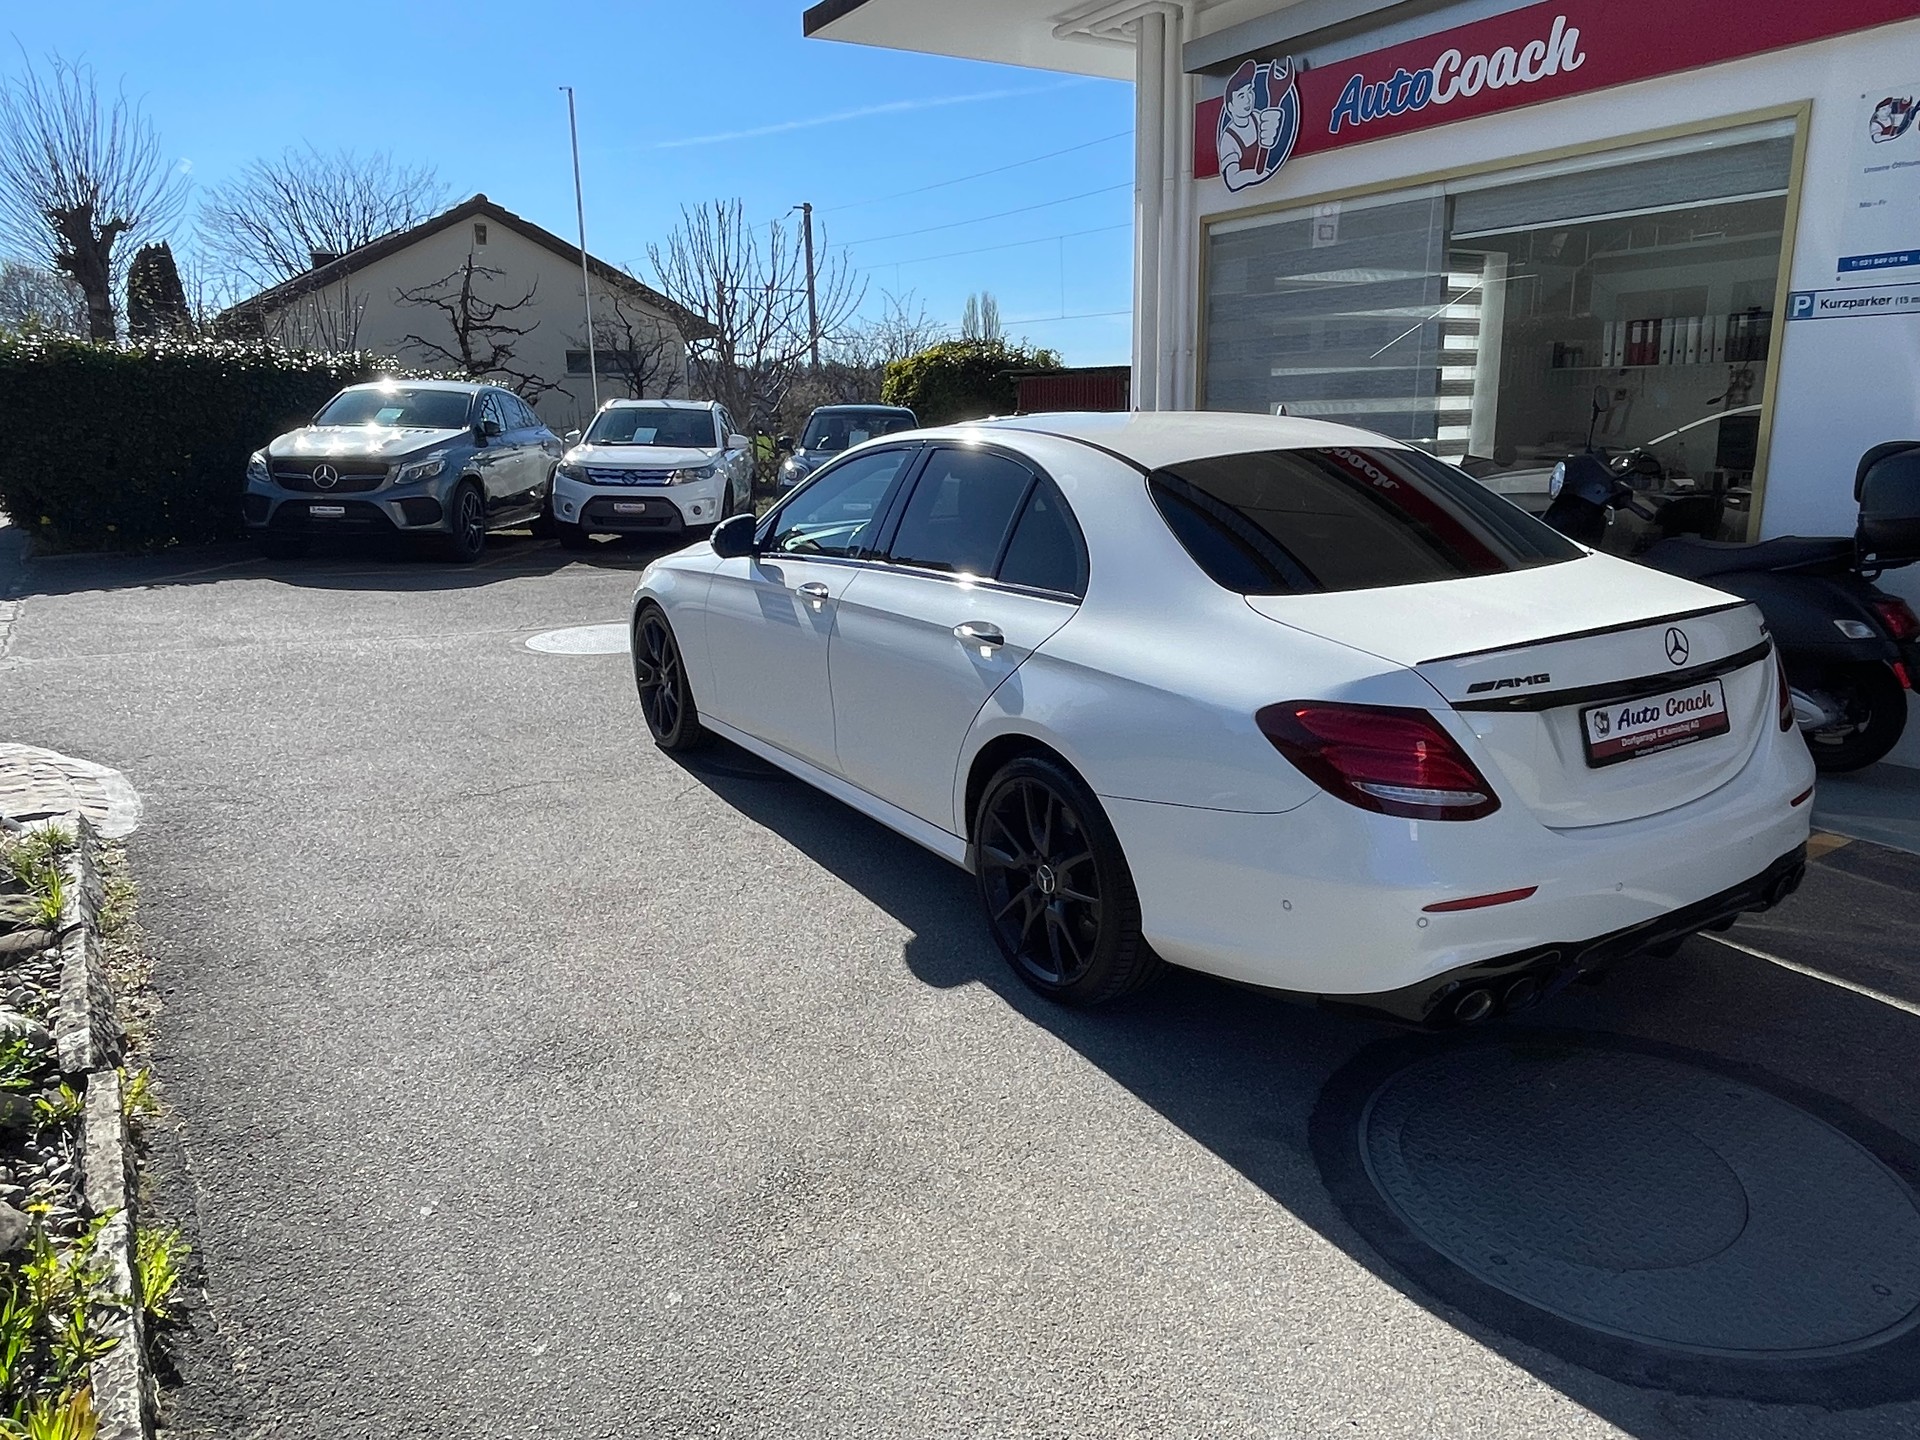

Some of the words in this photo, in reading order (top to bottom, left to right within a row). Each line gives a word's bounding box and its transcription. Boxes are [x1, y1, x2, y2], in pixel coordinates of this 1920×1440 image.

[1329, 16, 1585, 133] AutoCoach
[1820, 296, 1893, 310] Kurzparker
[1895, 296, 1909, 306] (15
[1495, 673, 1551, 690] AMG
[1617, 706, 1660, 730] Auto
[1665, 690, 1714, 717] Coach
[1621, 731, 1656, 747] Dorfgarage
